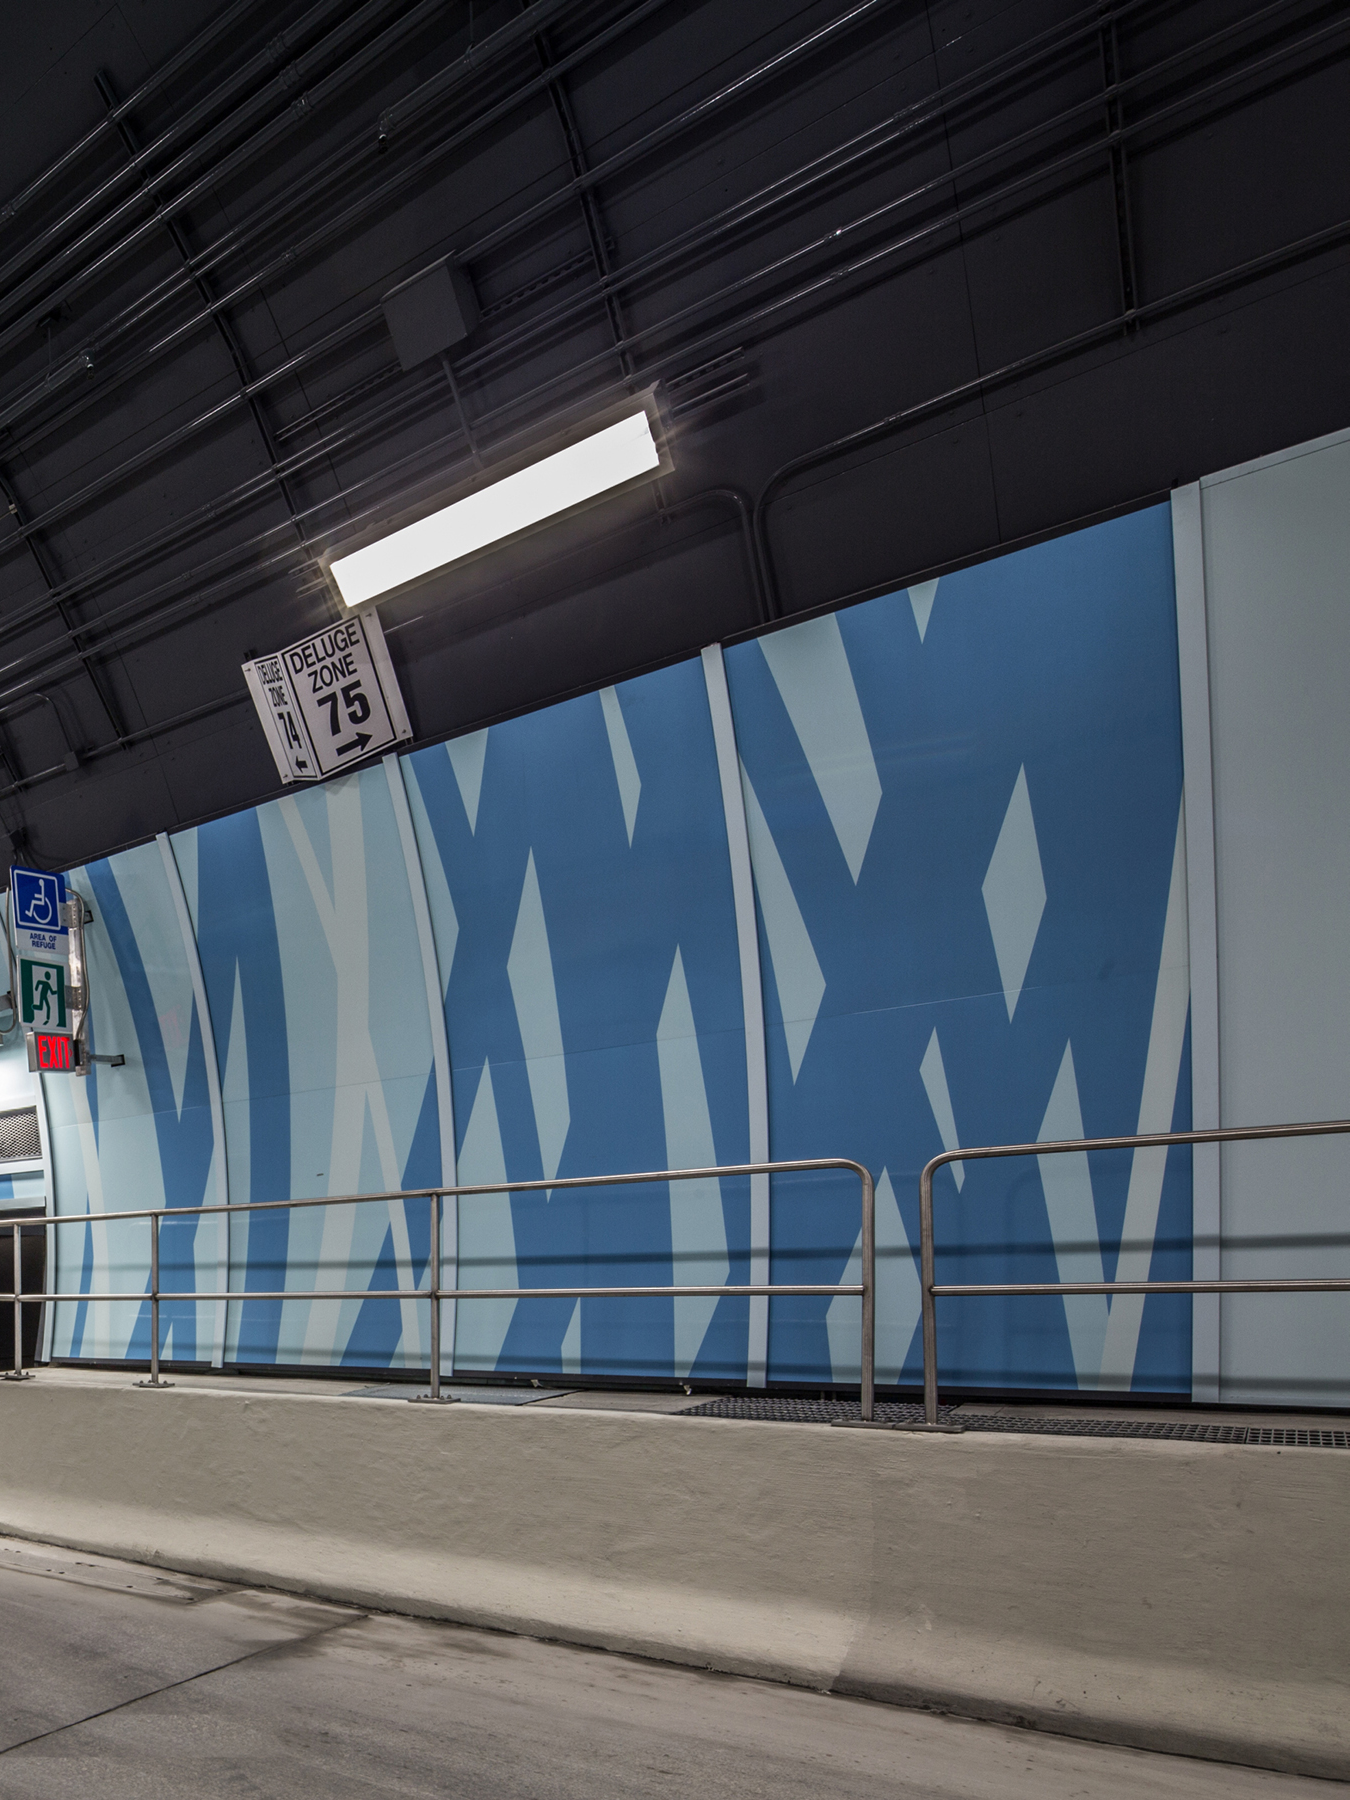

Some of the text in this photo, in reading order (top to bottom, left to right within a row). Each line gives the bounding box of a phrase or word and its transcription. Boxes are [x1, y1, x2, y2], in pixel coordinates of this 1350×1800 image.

[289, 623, 360, 674] DELUGE
[307, 653, 358, 694] ZONE
[316, 679, 371, 737] 75
[277, 711, 302, 749] 74
[30, 933, 57, 943] AREA OF
[32, 941, 56, 950] REFUGE
[38, 1035, 70, 1068] EXIT
